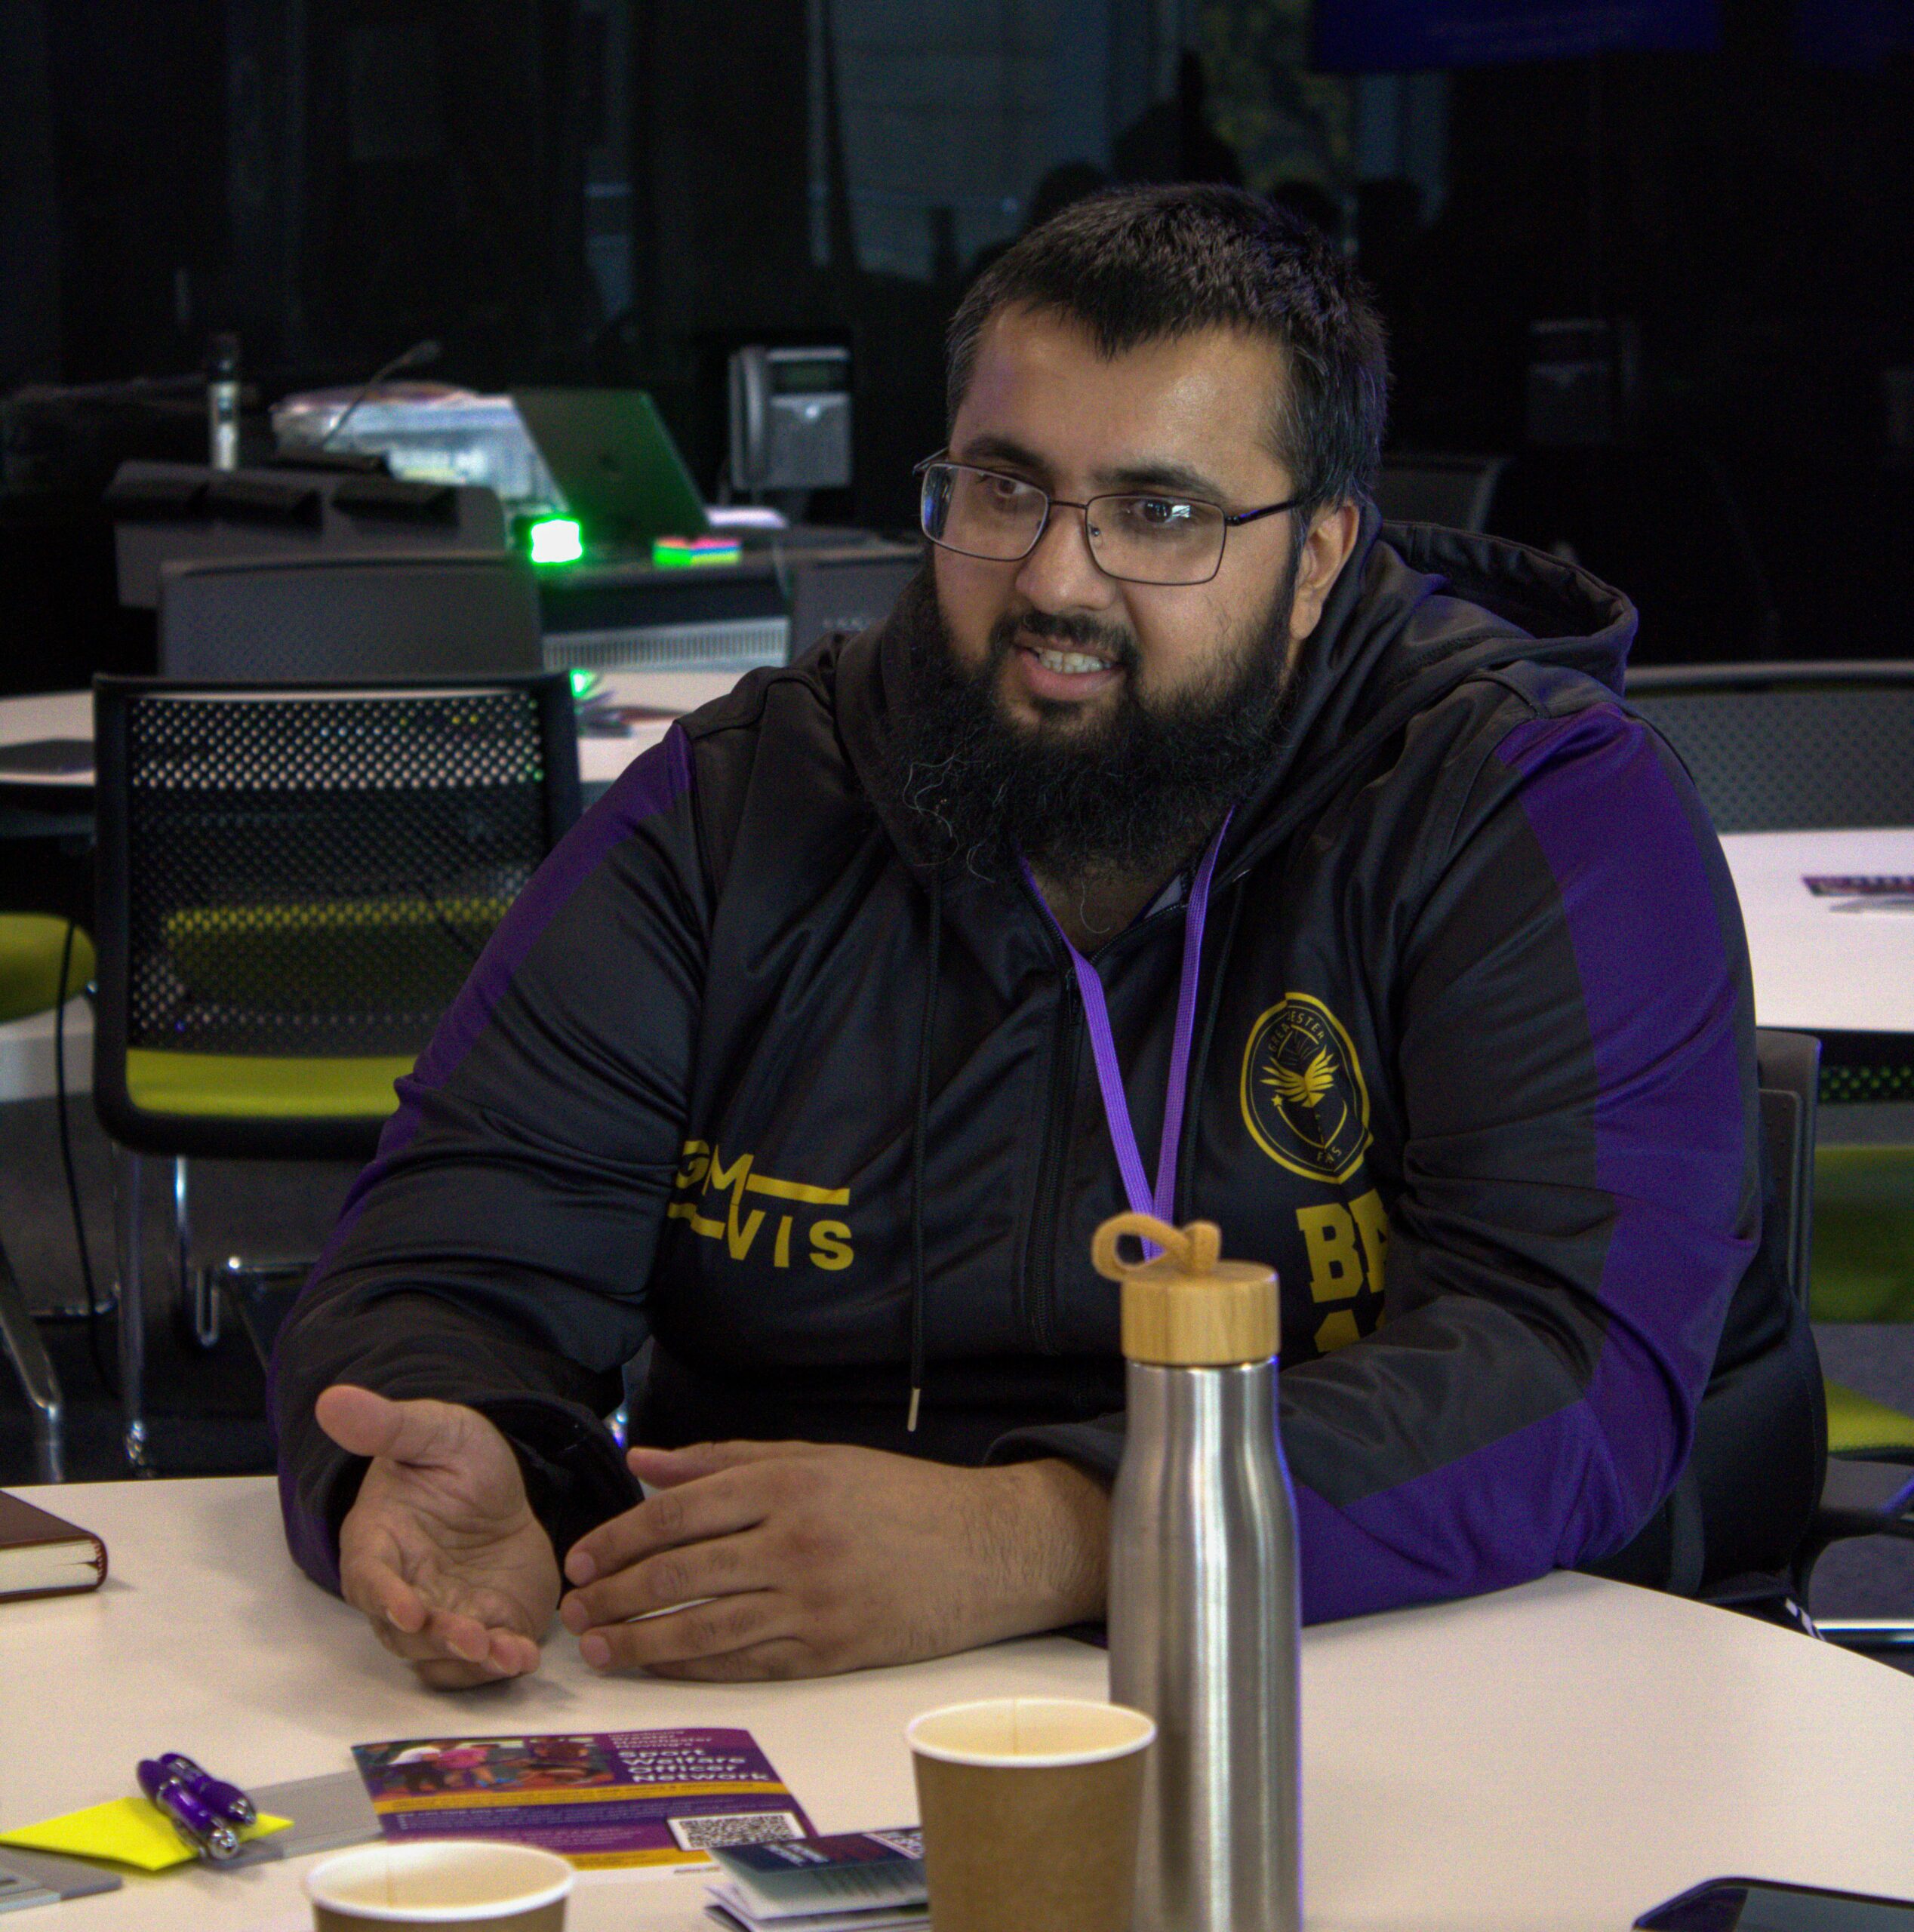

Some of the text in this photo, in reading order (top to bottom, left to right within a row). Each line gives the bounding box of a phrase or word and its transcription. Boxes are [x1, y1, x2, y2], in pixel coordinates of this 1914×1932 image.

[617, 1749, 706, 1758] Sport
[622, 1755, 746, 1765] Welfare
[627, 1764, 737, 1774] Officer
[632, 1772, 770, 1782] Network
